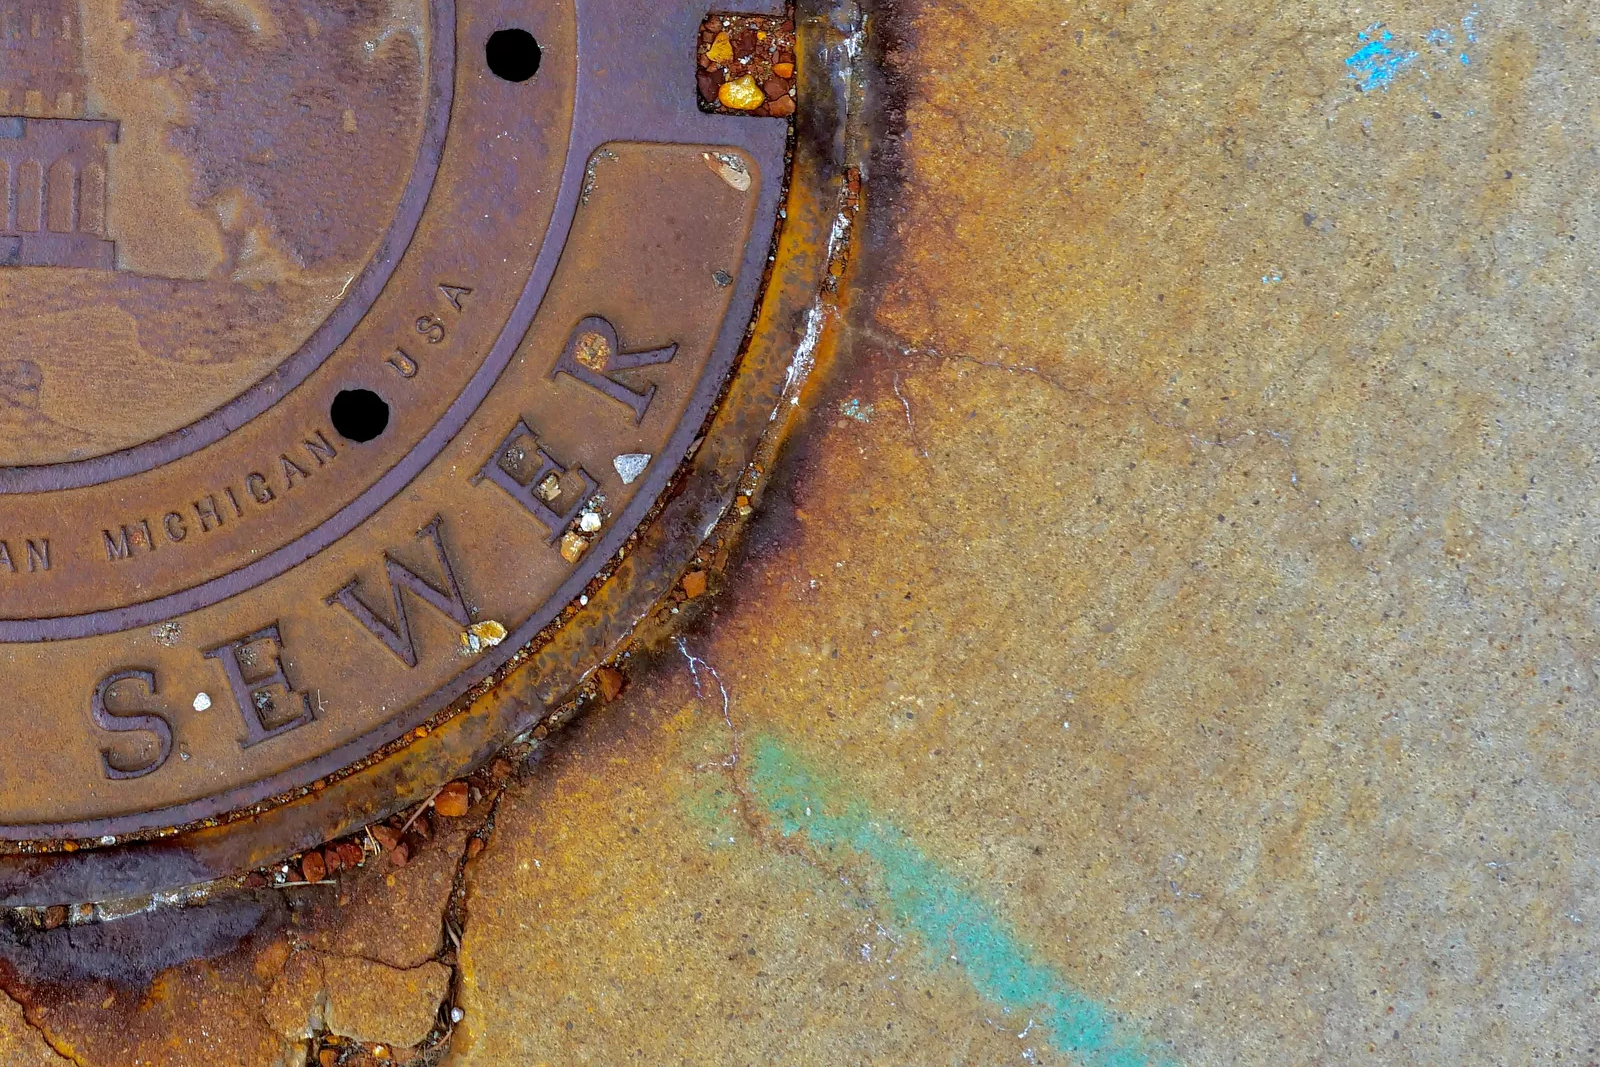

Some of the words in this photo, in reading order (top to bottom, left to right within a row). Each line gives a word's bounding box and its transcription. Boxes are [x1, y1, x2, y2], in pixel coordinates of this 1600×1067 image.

[92, 314, 679, 781] SEWER
[102, 429, 338, 561] MICHIGAN
[388, 281, 472, 380] USA
